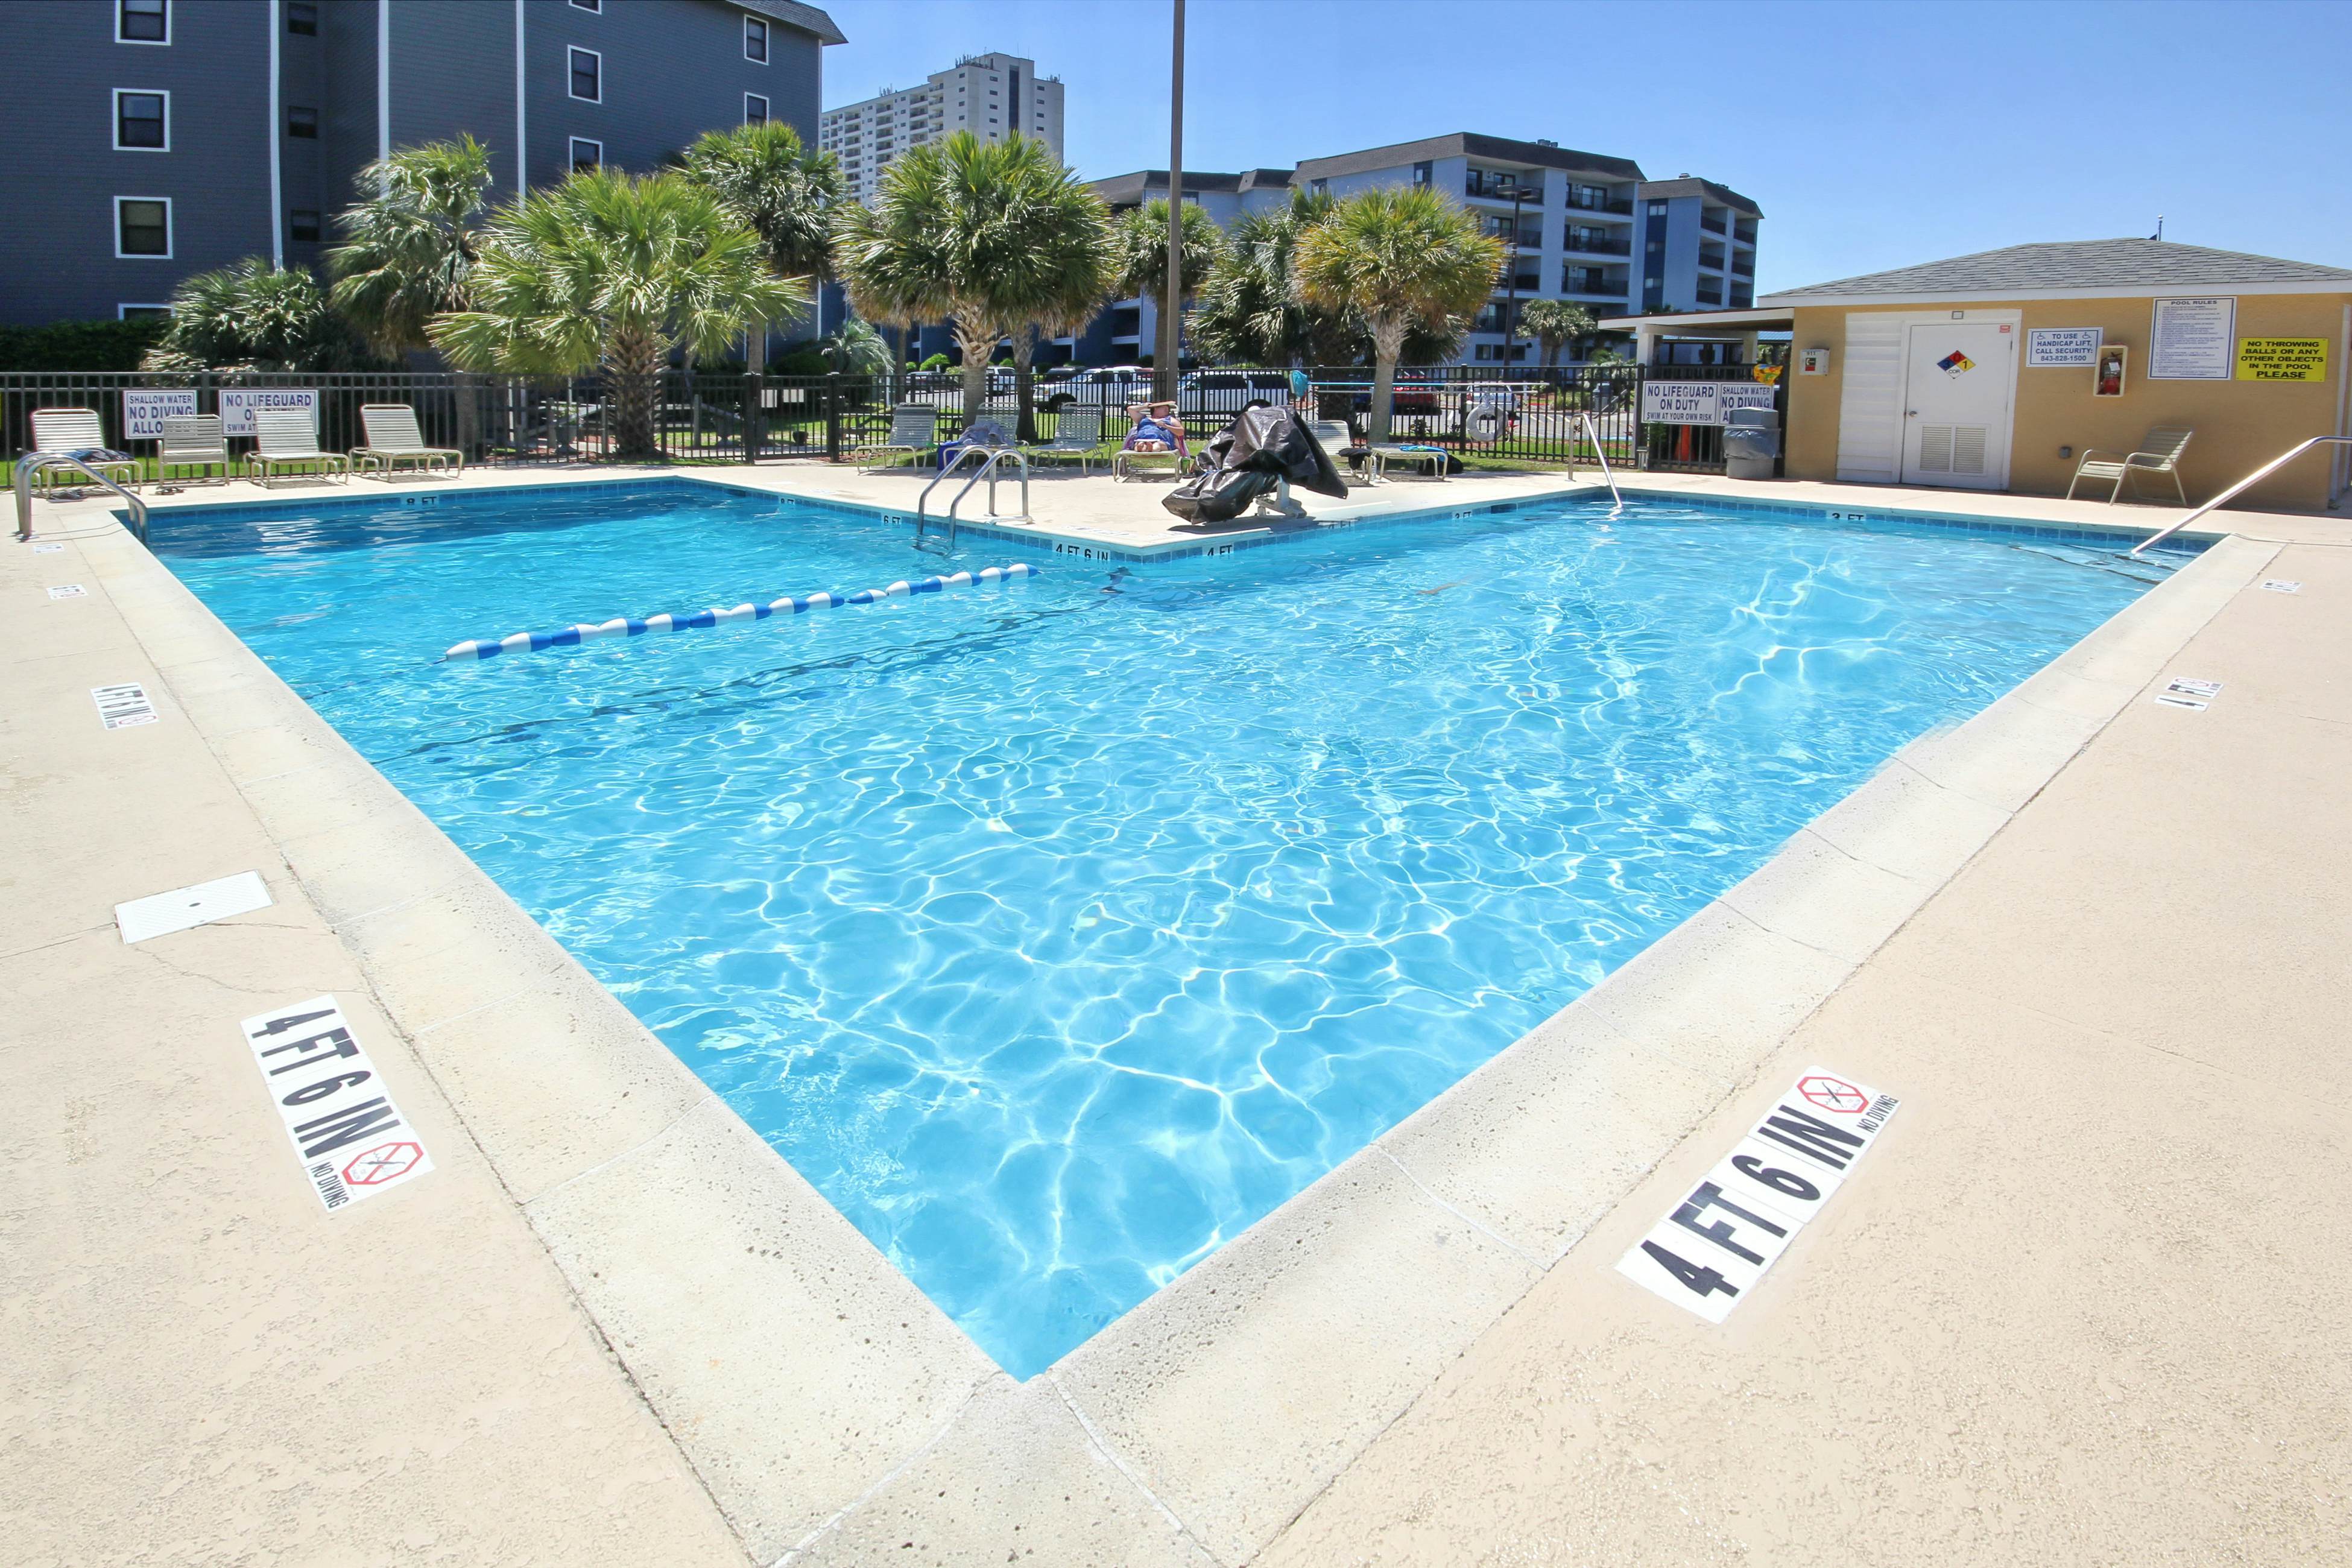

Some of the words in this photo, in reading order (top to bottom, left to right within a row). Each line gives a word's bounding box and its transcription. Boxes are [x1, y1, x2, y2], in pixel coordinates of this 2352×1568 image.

[226, 395, 242, 406] NO
[247, 394, 311, 406] LIFEGUARD
[1648, 385, 1660, 396] NO
[1663, 386, 1714, 397] LIFEGUARD
[1660, 399, 1672, 409] ON
[1675, 399, 1700, 410] DUTY
[1722, 397, 1734, 408] NO
[1737, 397, 1769, 408] DIVING
[129, 406, 146, 419] NO
[151, 406, 193, 419] DIVING
[1067, 545, 1080, 555] FT
[1084, 549, 1091, 558] 6
[1097, 551, 1108, 561] IN
[1219, 545, 1233, 555] FT
[251, 1008, 337, 1038] 4
[261, 1026, 359, 1076] FT
[282, 1070, 371, 1106] 6
[1865, 1095, 1899, 1122] DIVING
[293, 1096, 400, 1159] IN
[1757, 1104, 1866, 1171] IN
[1856, 1118, 1879, 1134] NO
[311, 1162, 334, 1178] NO
[1731, 1155, 1821, 1201] 6
[317, 1174, 349, 1209] DIVING
[1669, 1181, 1788, 1266] FT
[1640, 1239, 1740, 1298] 4
